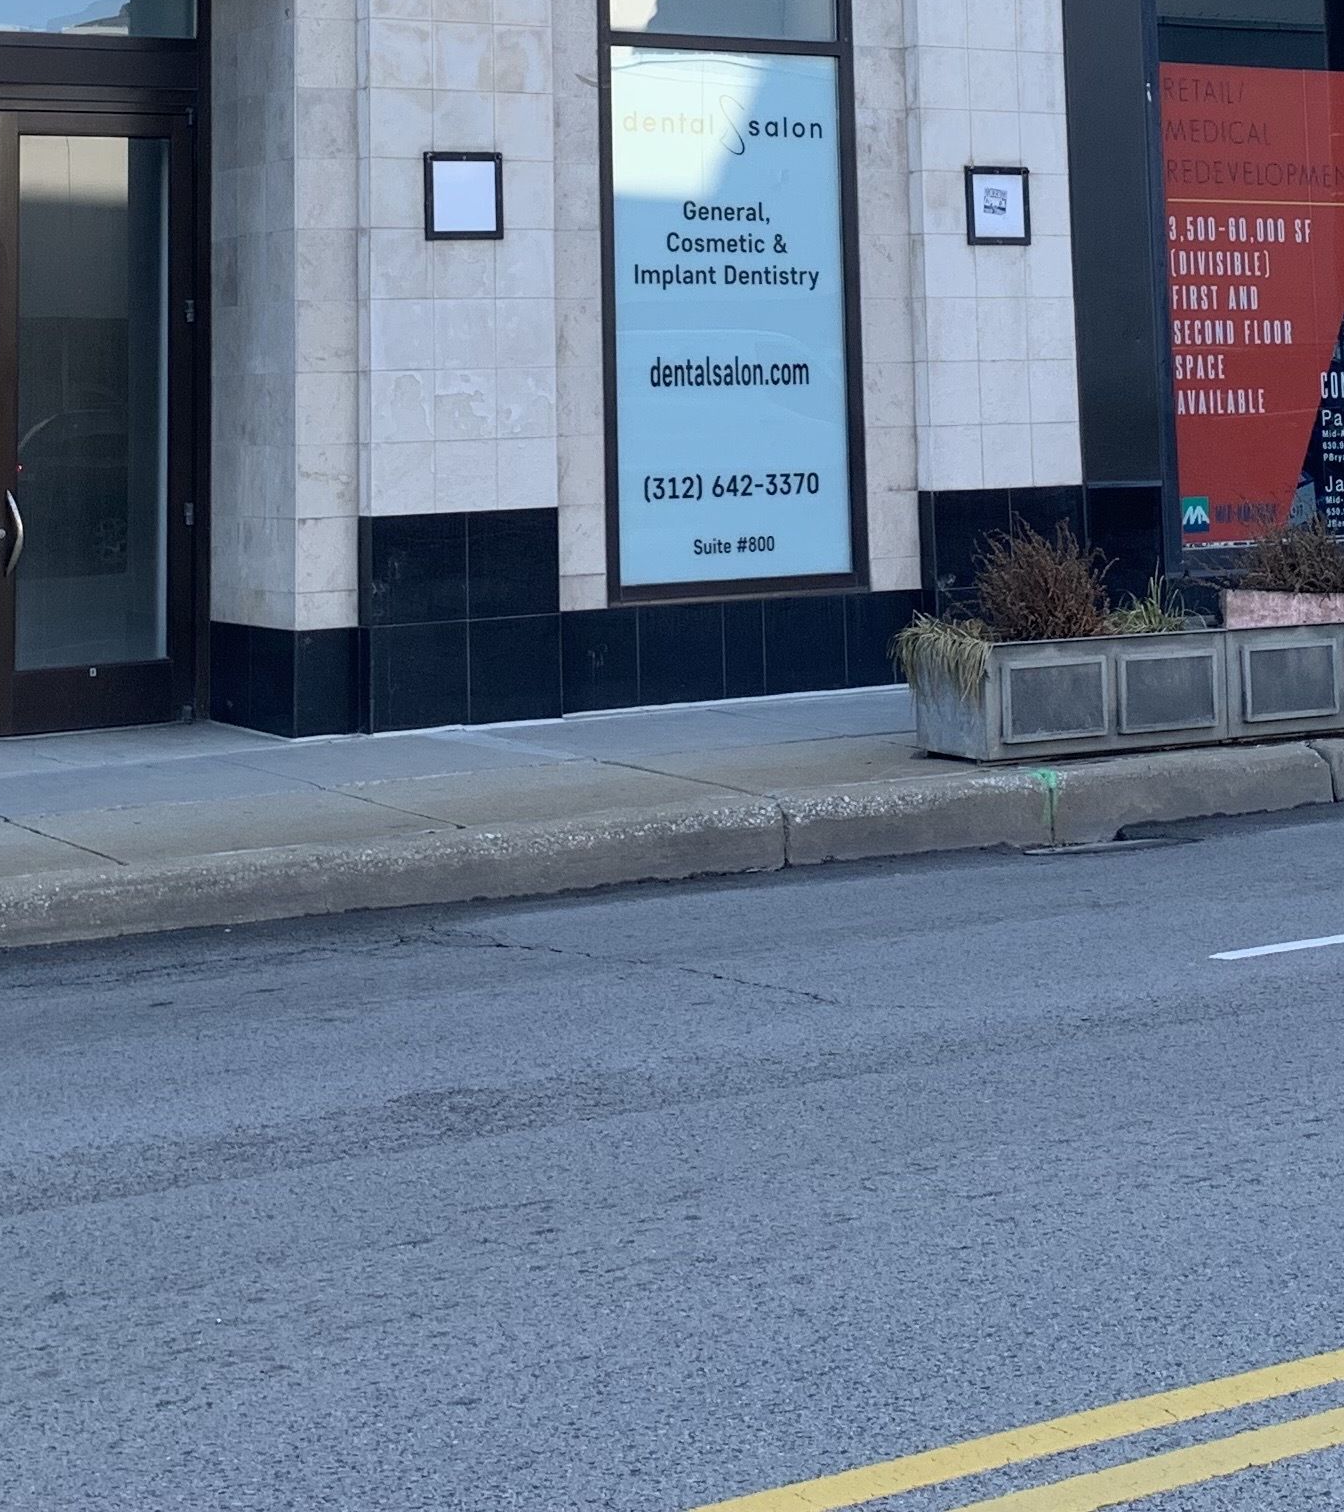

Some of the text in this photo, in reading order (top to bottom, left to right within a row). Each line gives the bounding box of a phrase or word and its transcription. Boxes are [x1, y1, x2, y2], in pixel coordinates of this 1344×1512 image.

[623, 110, 823, 139] dental salon
[1164, 119, 1273, 146] MEDICAL
[682, 201, 771, 225] General,
[666, 231, 788, 254] Cosmetic &
[1168, 216, 1312, 244] 3,500-60,000 SF
[1170, 250, 1271, 278] (DIVISIBLE)
[634, 264, 819, 291] Implant Dentistry
[1172, 285, 1258, 311] FIRST AND
[1174, 319, 1293, 345] SECOND FLOOR
[650, 356, 810, 388] dentalsalon.com
[1175, 354, 1225, 380] SPACE
[1177, 389, 1266, 415] AVAILABLE
[643, 472, 819, 503] (312) 642-3370
[693, 536, 775, 555] Suite #800
